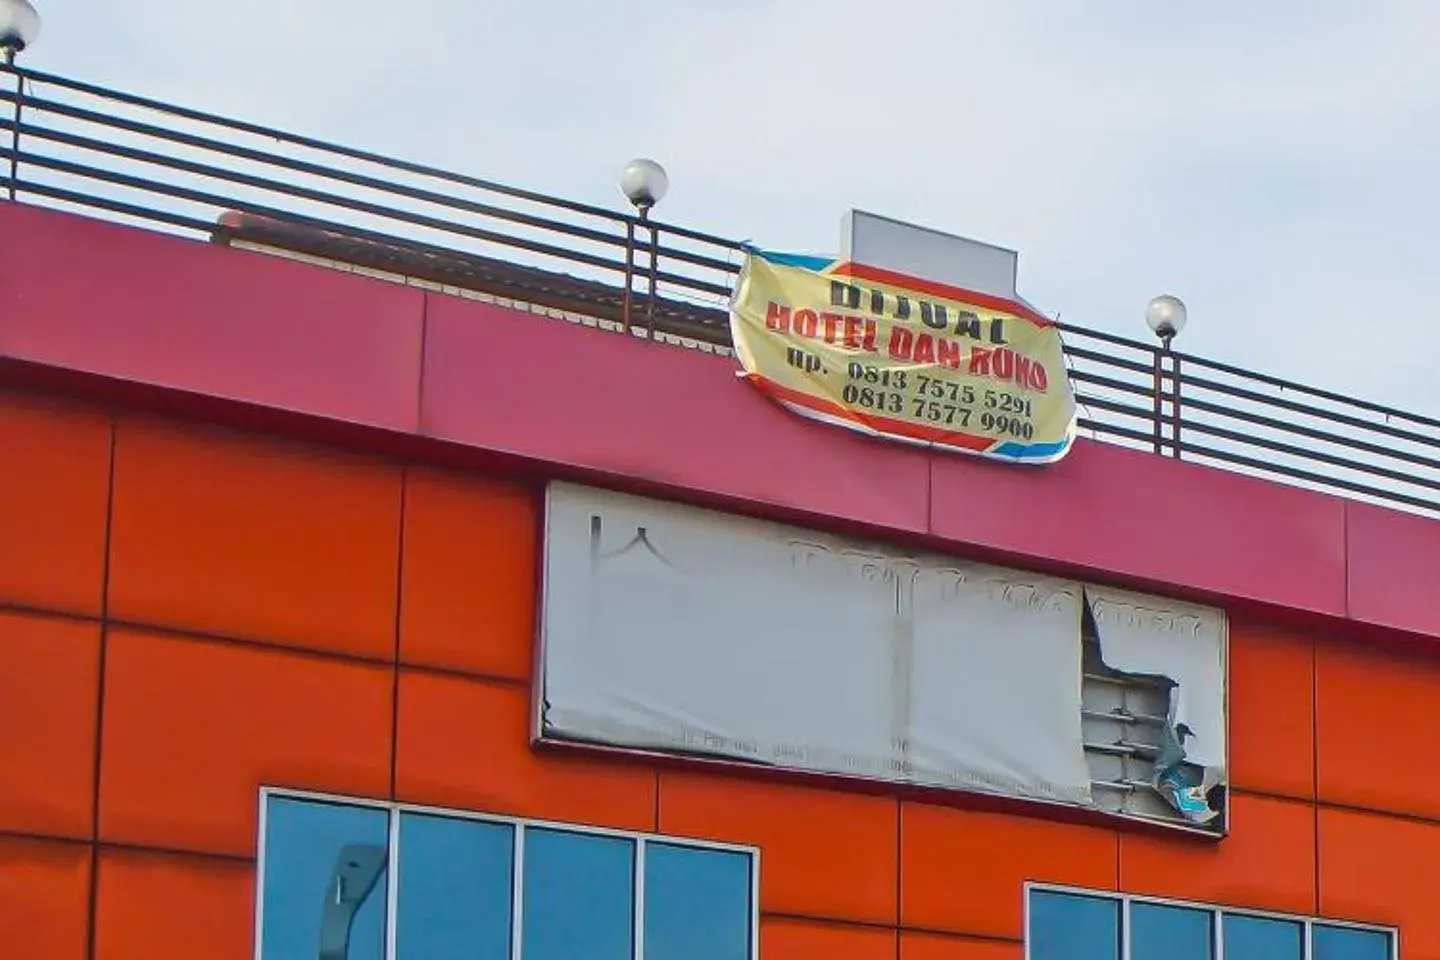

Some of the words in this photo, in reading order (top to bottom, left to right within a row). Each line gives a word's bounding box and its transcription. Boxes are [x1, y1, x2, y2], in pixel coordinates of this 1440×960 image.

[831, 280, 1009, 345] DIJUAL
[766, 301, 878, 352] HOTEL
[889, 326, 961, 369] DAN
[969, 347, 1048, 390] RUKO
[842, 383, 904, 413] 0813
[912, 399, 973, 427] 7577
[981, 412, 1034, 441] 9900
[848, 361, 907, 390] 0813
[917, 375, 976, 405] 7575
[984, 389, 1032, 418] 5291
